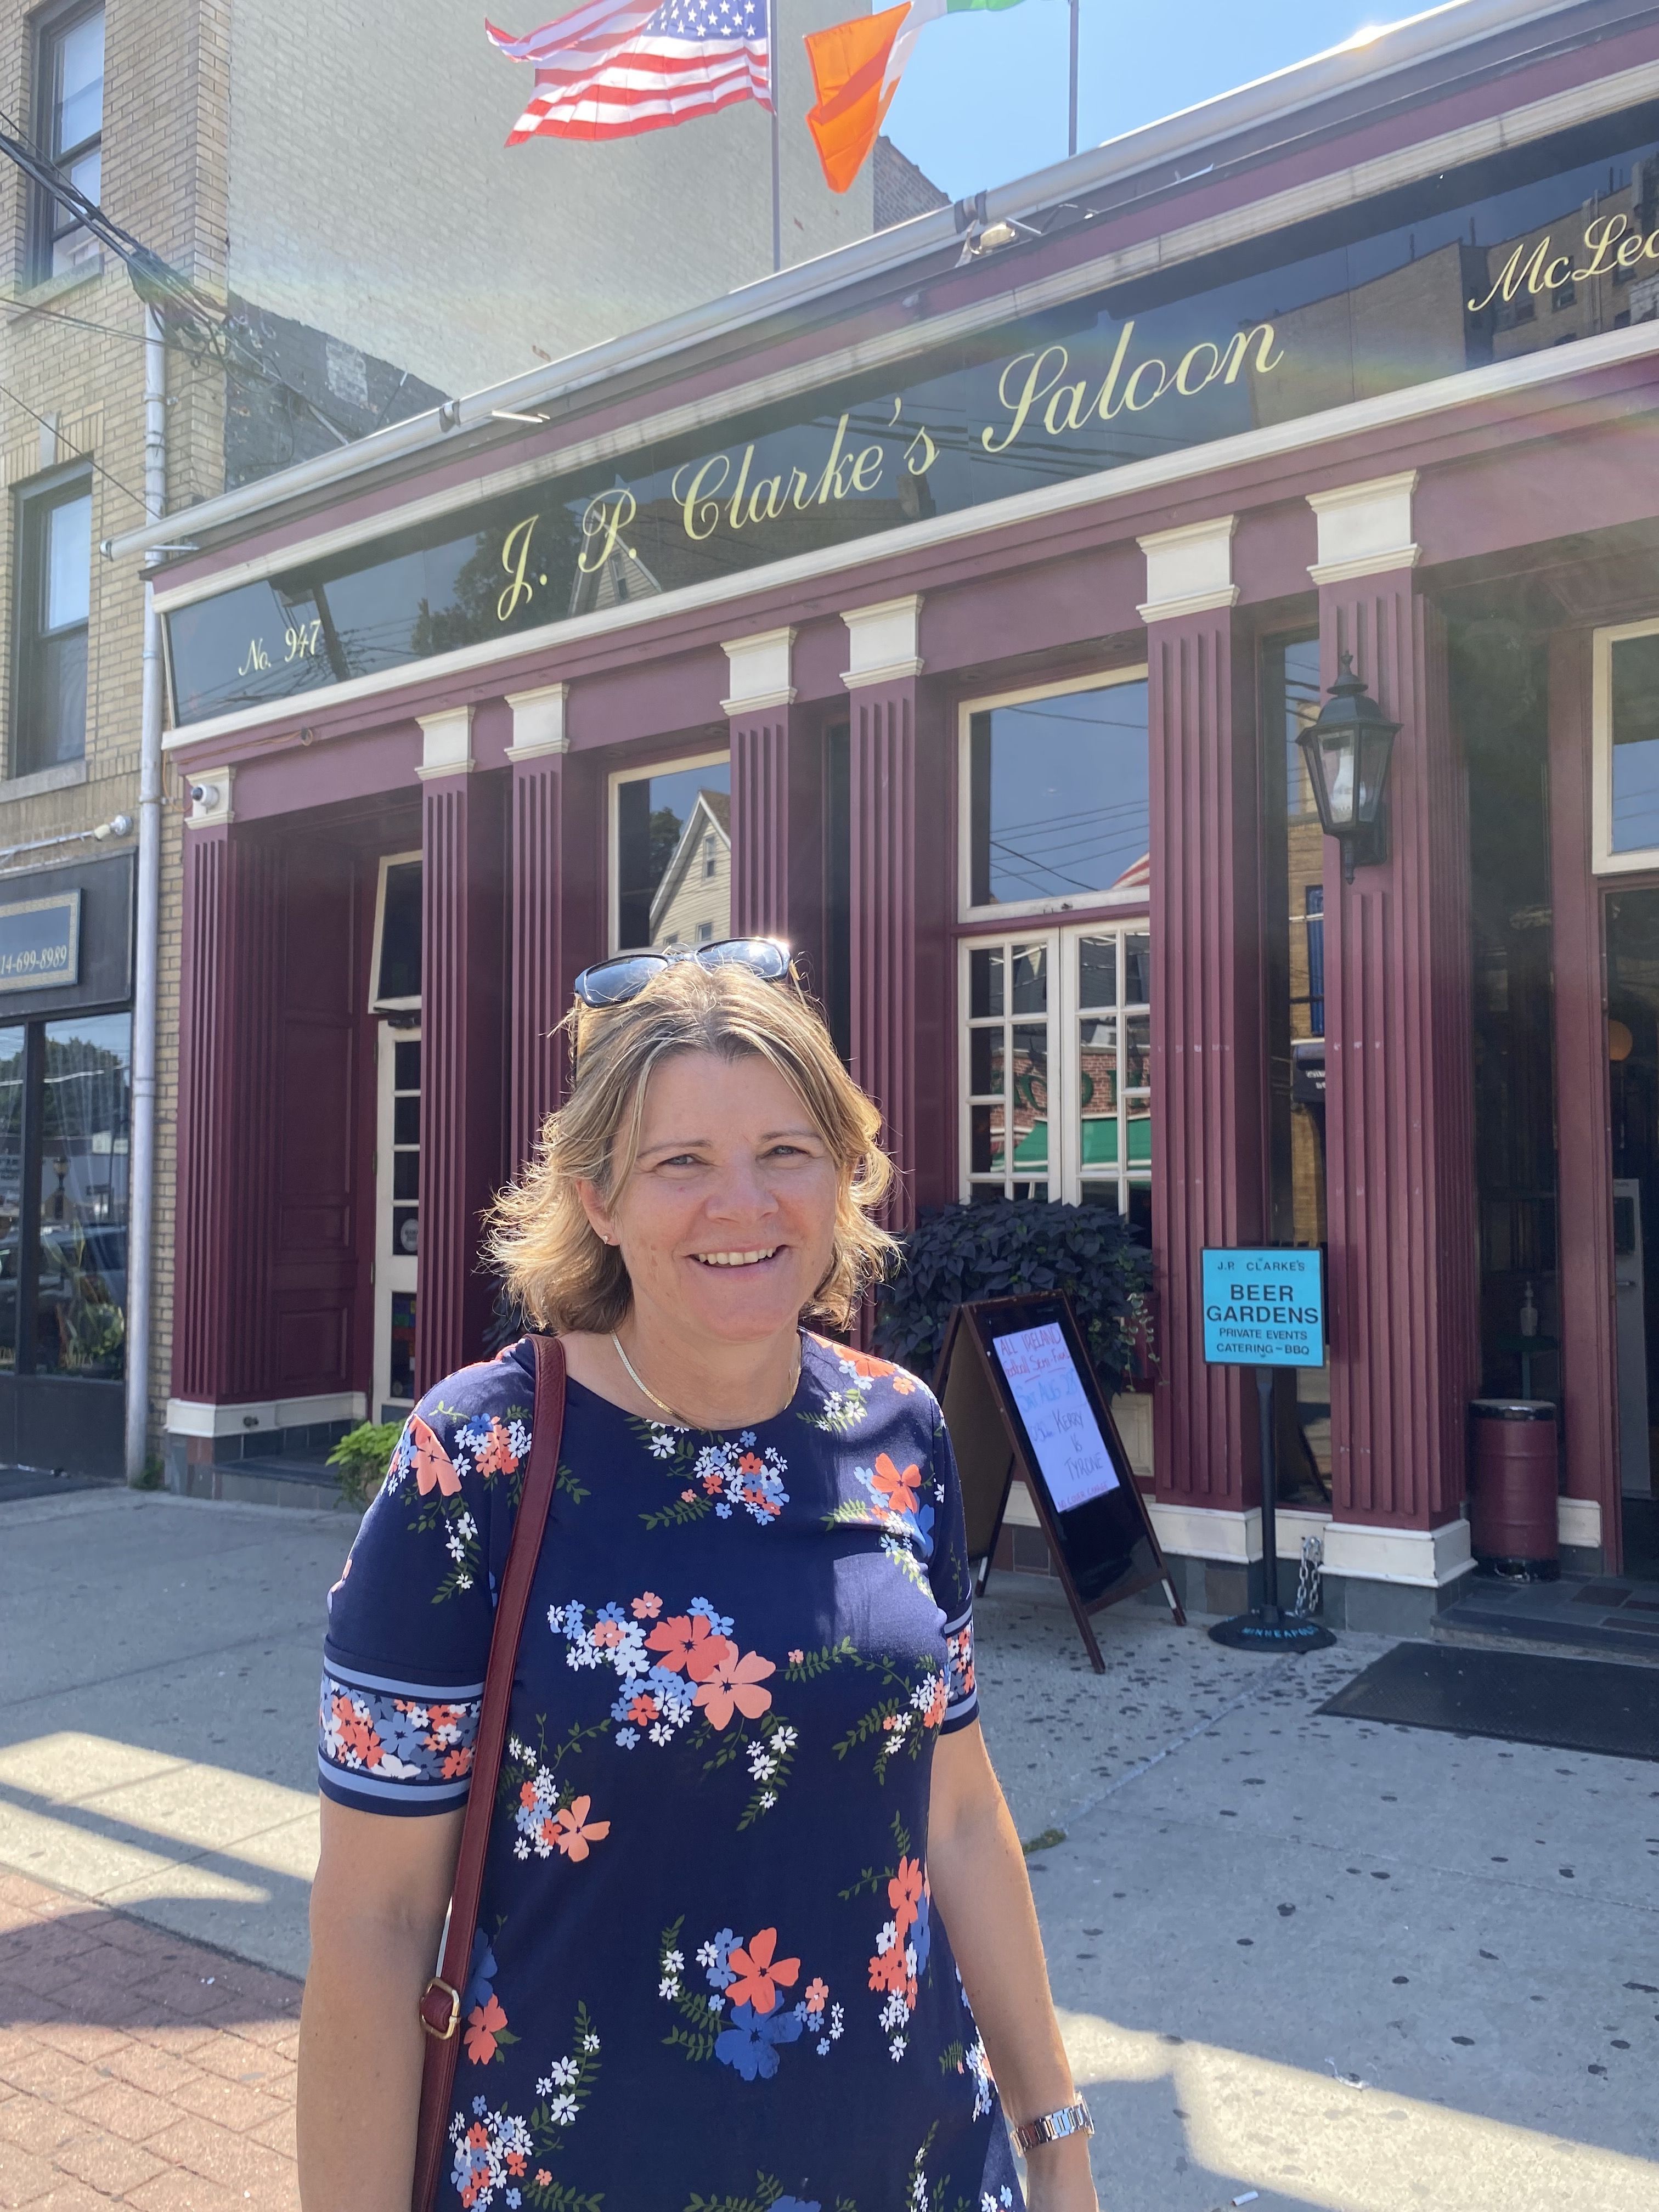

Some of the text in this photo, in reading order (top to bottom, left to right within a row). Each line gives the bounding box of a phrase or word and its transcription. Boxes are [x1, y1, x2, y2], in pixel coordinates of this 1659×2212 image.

[496, 320, 1284, 622] J. P. Clarke's Saloon
[238, 619, 321, 676] No. 947
[1246, 1260, 1305, 1272] CLARKE'S
[1230, 1284, 1294, 1302] BEER
[1206, 1305, 1319, 1324] GARDENS
[1000, 1325, 1062, 1356] ALL IRELAND
[1219, 1327, 1308, 1340] PRIVATE EVENTS
[1216, 1342, 1273, 1354] CATERING
[1284, 1345, 1310, 1355] BBQ
[1052, 1408, 1084, 1434] KERRY
[1064, 1452, 1103, 1481] TYRONE
